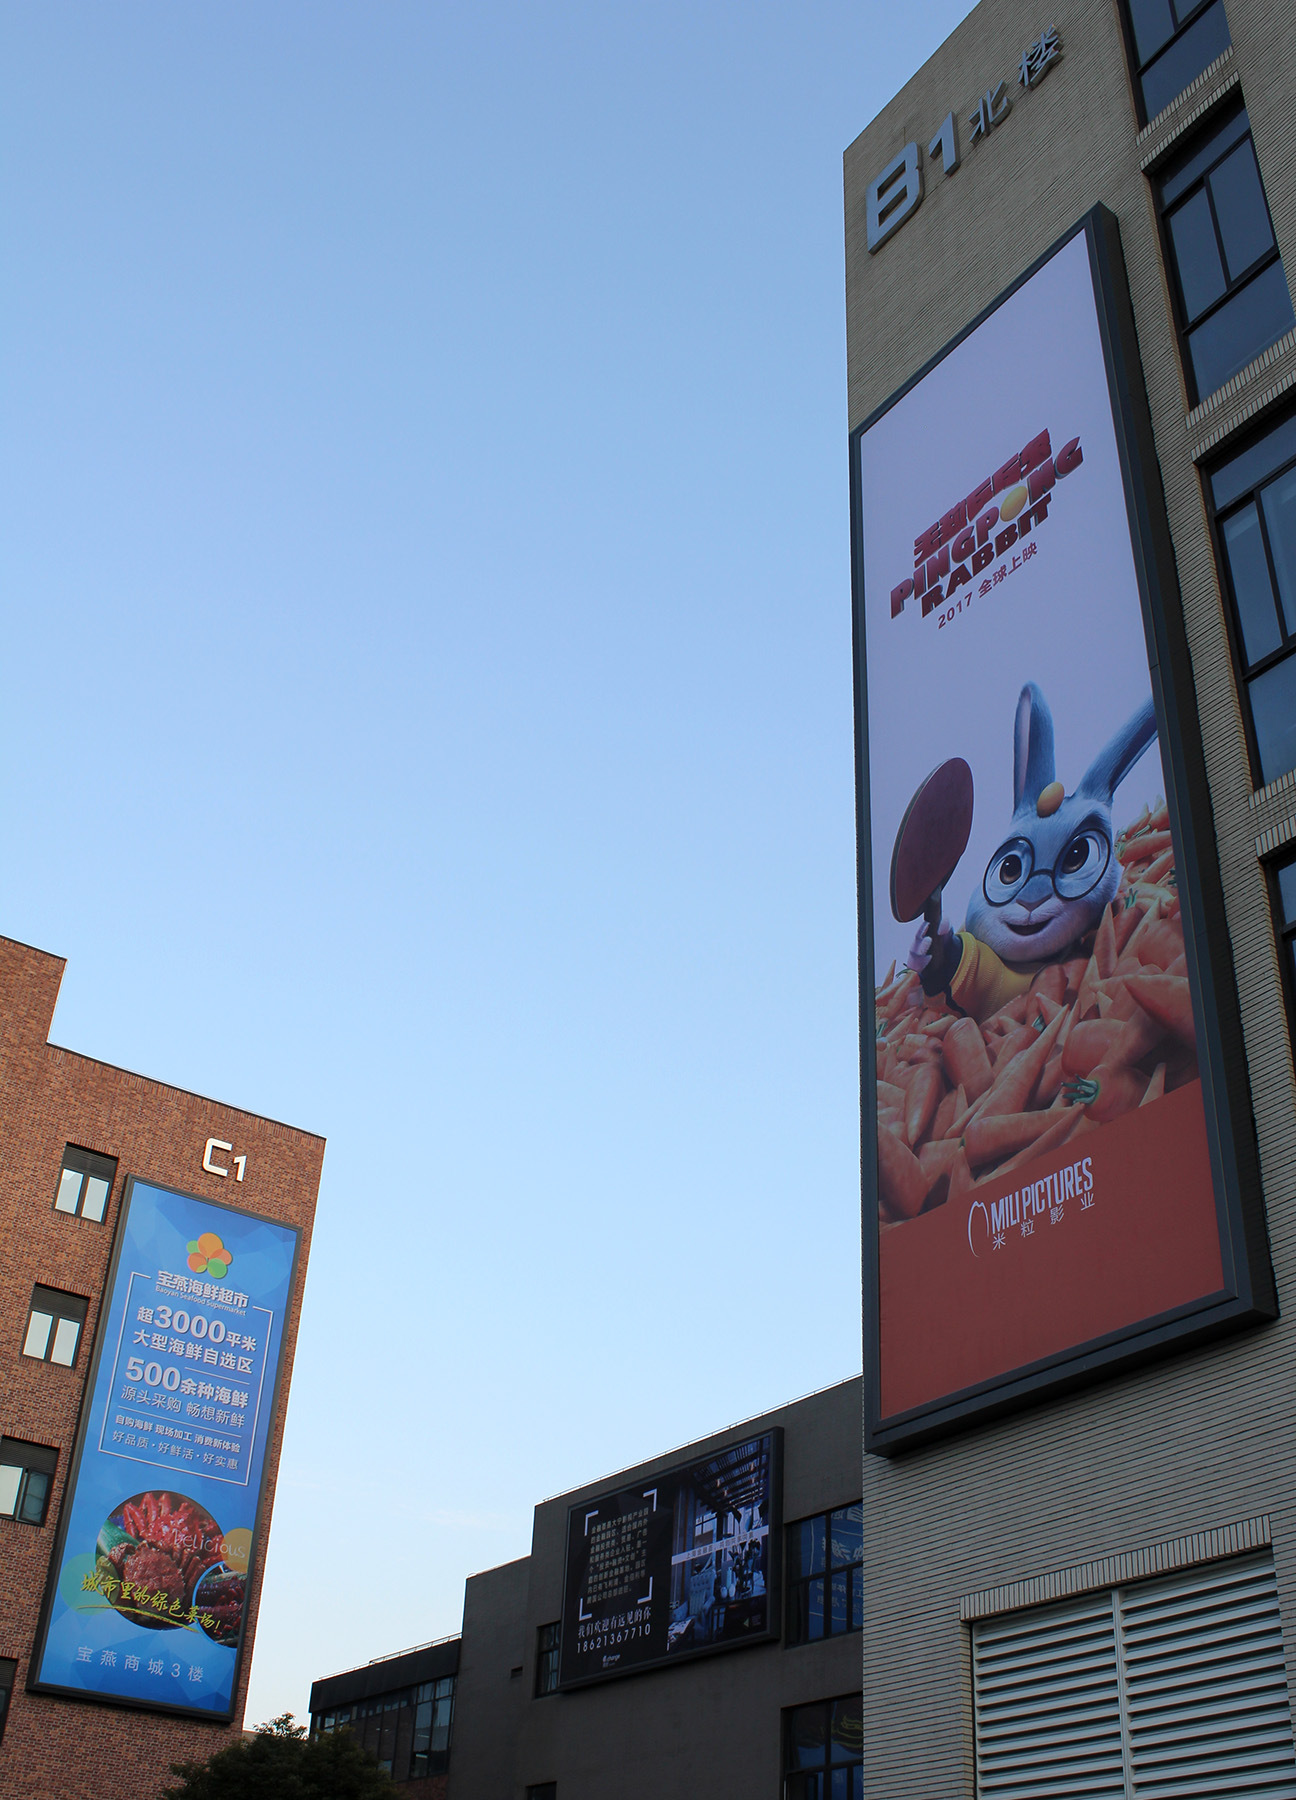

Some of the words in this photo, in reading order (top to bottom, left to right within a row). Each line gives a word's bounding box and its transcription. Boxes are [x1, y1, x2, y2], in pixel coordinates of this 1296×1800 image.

[922, 491, 1053, 618] RABBIT
[937, 592, 973, 629] 2017
[978, 541, 1038, 599] 全球上映
[202, 1137, 247, 1182] C1
[1021, 1156, 1094, 1220] PICTURES
[992, 1191, 1095, 1251] 米粒影业
[155, 1270, 250, 1309] 宝燕海鲜超市
[155, 1285, 180, 1298] Baoyan
[180, 1291, 206, 1306] Seafood
[206, 1298, 246, 1316] Supermarket
[133, 1327, 254, 1375] 大型海鲜自选区
[125, 1356, 250, 1409] 500余种海鲜
[120, 1384, 182, 1413] 源头采购
[186, 1401, 246, 1428] 畅想新鲜
[115, 1413, 153, 1433] 自购海鲜
[155, 1423, 193, 1442] 现场加工
[194, 1433, 241, 1453] 消费新体验
[172, 1527, 247, 1559] Delicious
[577, 1623, 651, 1654] 18621367710
[578, 1606, 652, 1639] 我们欢迎有远见的你
[75, 1646, 204, 1682] 宝燕商城3楼
